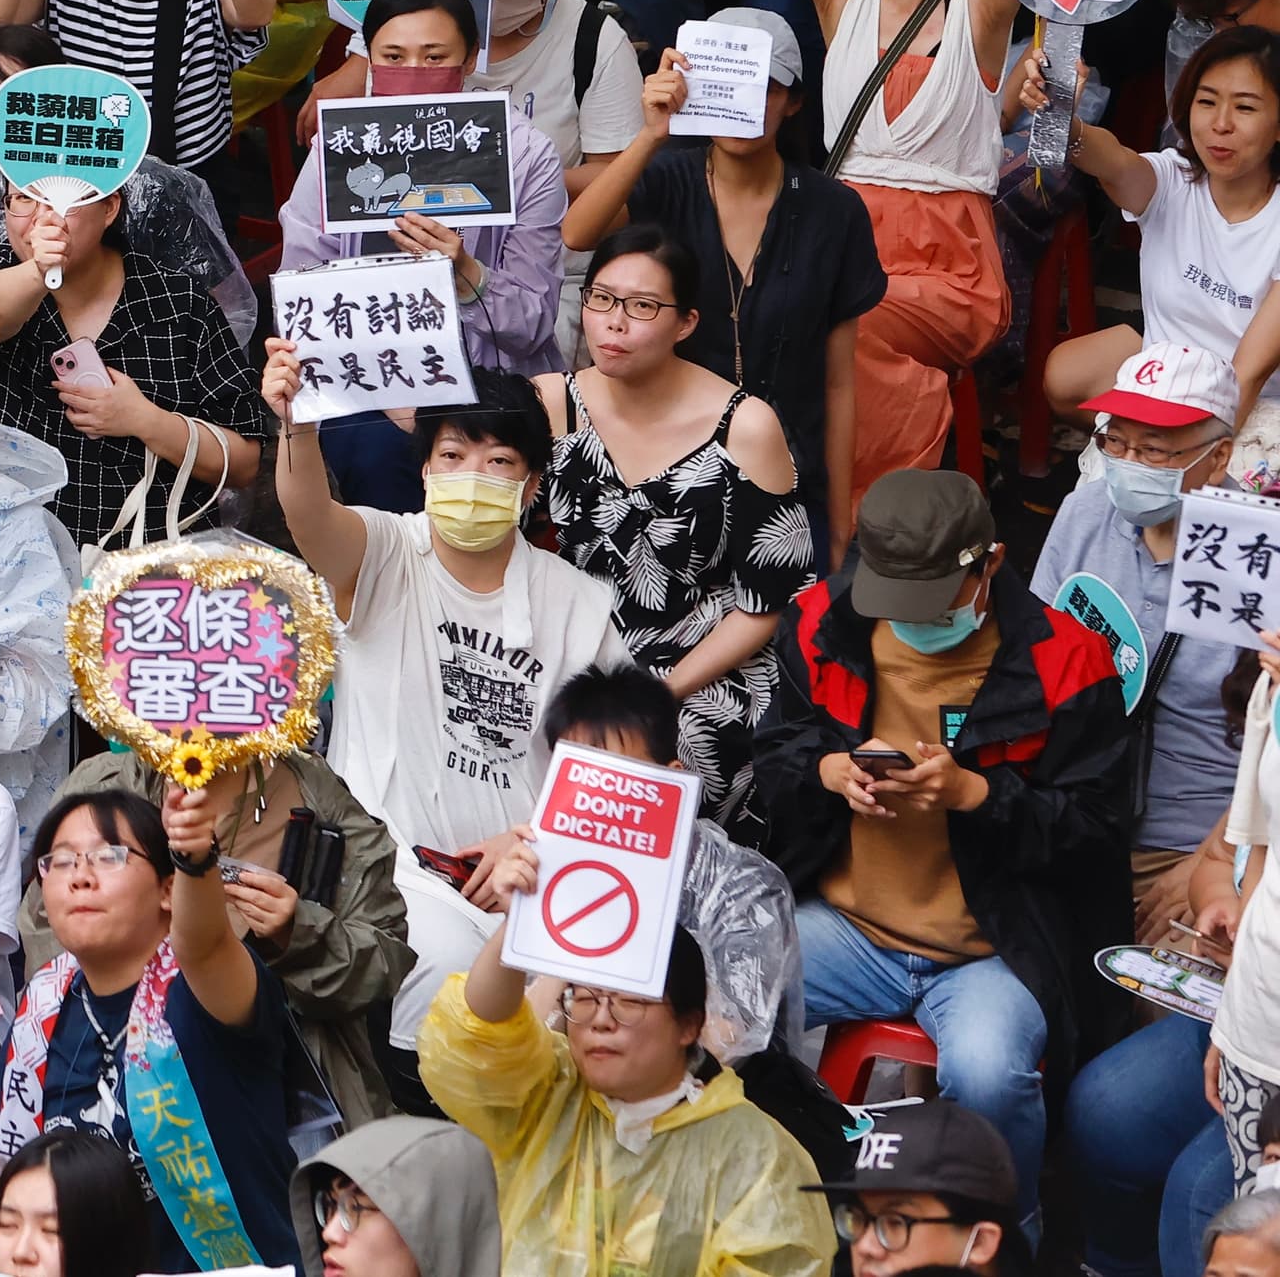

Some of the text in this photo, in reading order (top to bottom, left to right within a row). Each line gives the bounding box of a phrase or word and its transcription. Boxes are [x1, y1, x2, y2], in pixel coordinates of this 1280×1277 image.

[6, 92, 97, 122] 我藐視
[5, 121, 125, 151] 藍白黑箱
[328, 118, 491, 157] 我藐視國會
[285, 287, 446, 342] 沒有討論
[297, 344, 460, 392] 不是民主
[114, 584, 249, 655] 逐條
[127, 652, 266, 725] 審查
[567, 762, 665, 806] DISCUSS,
[573, 790, 646, 824] DON'T
[554, 812, 658, 854] DICTATE!
